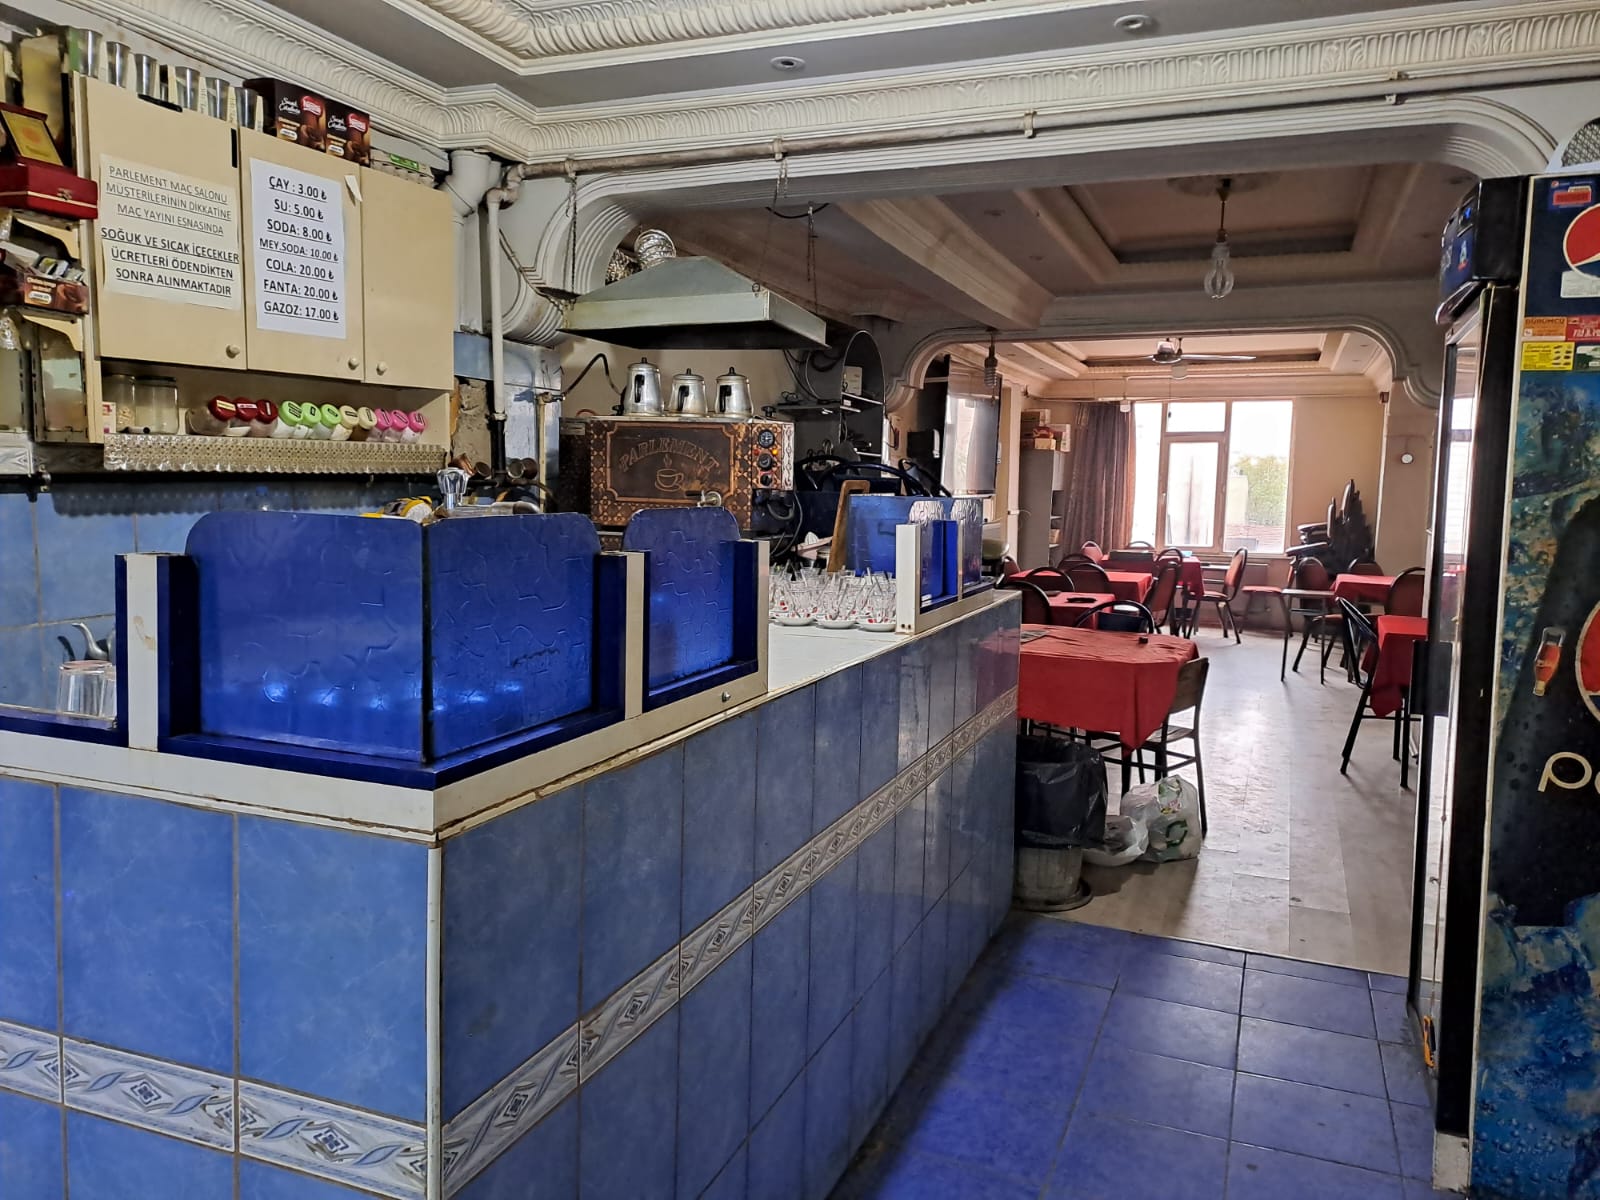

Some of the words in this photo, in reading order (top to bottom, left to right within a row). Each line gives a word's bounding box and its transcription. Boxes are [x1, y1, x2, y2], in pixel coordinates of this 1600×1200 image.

[109, 166, 167, 187] PARLEMENT
[195, 187, 227, 203] SALONU
[269, 176, 290, 191] ÇAY
[298, 184, 319, 198] 3.00
[189, 200, 231, 219] DİKKATİNE
[274, 199, 291, 212] SU:
[294, 204, 315, 218] 5.00
[144, 210, 175, 224] YAYINI
[178, 218, 223, 235] ESNASINDA
[267, 219, 300, 236] SODA:
[303, 226, 324, 240] 8.00
[101, 227, 141, 244] SOĞUK
[144, 235, 158, 247] VE
[161, 238, 190, 252] SICAK
[192, 243, 239, 262] İÇECEKLER
[310, 248, 332, 260] 10.00
[111, 246, 169, 267] ÜCRETLERİ
[171, 256, 233, 278] ÖDENDİKTEN
[266, 258, 297, 273] COLA:
[299, 265, 326, 279] 20.00
[116, 268, 154, 283] SONRA
[156, 275, 231, 295] ALINMAKTADIR
[264, 279, 301, 295] FANTA:
[303, 285, 330, 300] 20.00
[264, 301, 302, 316] GAZOZ:
[305, 306, 331, 320] 17.00
